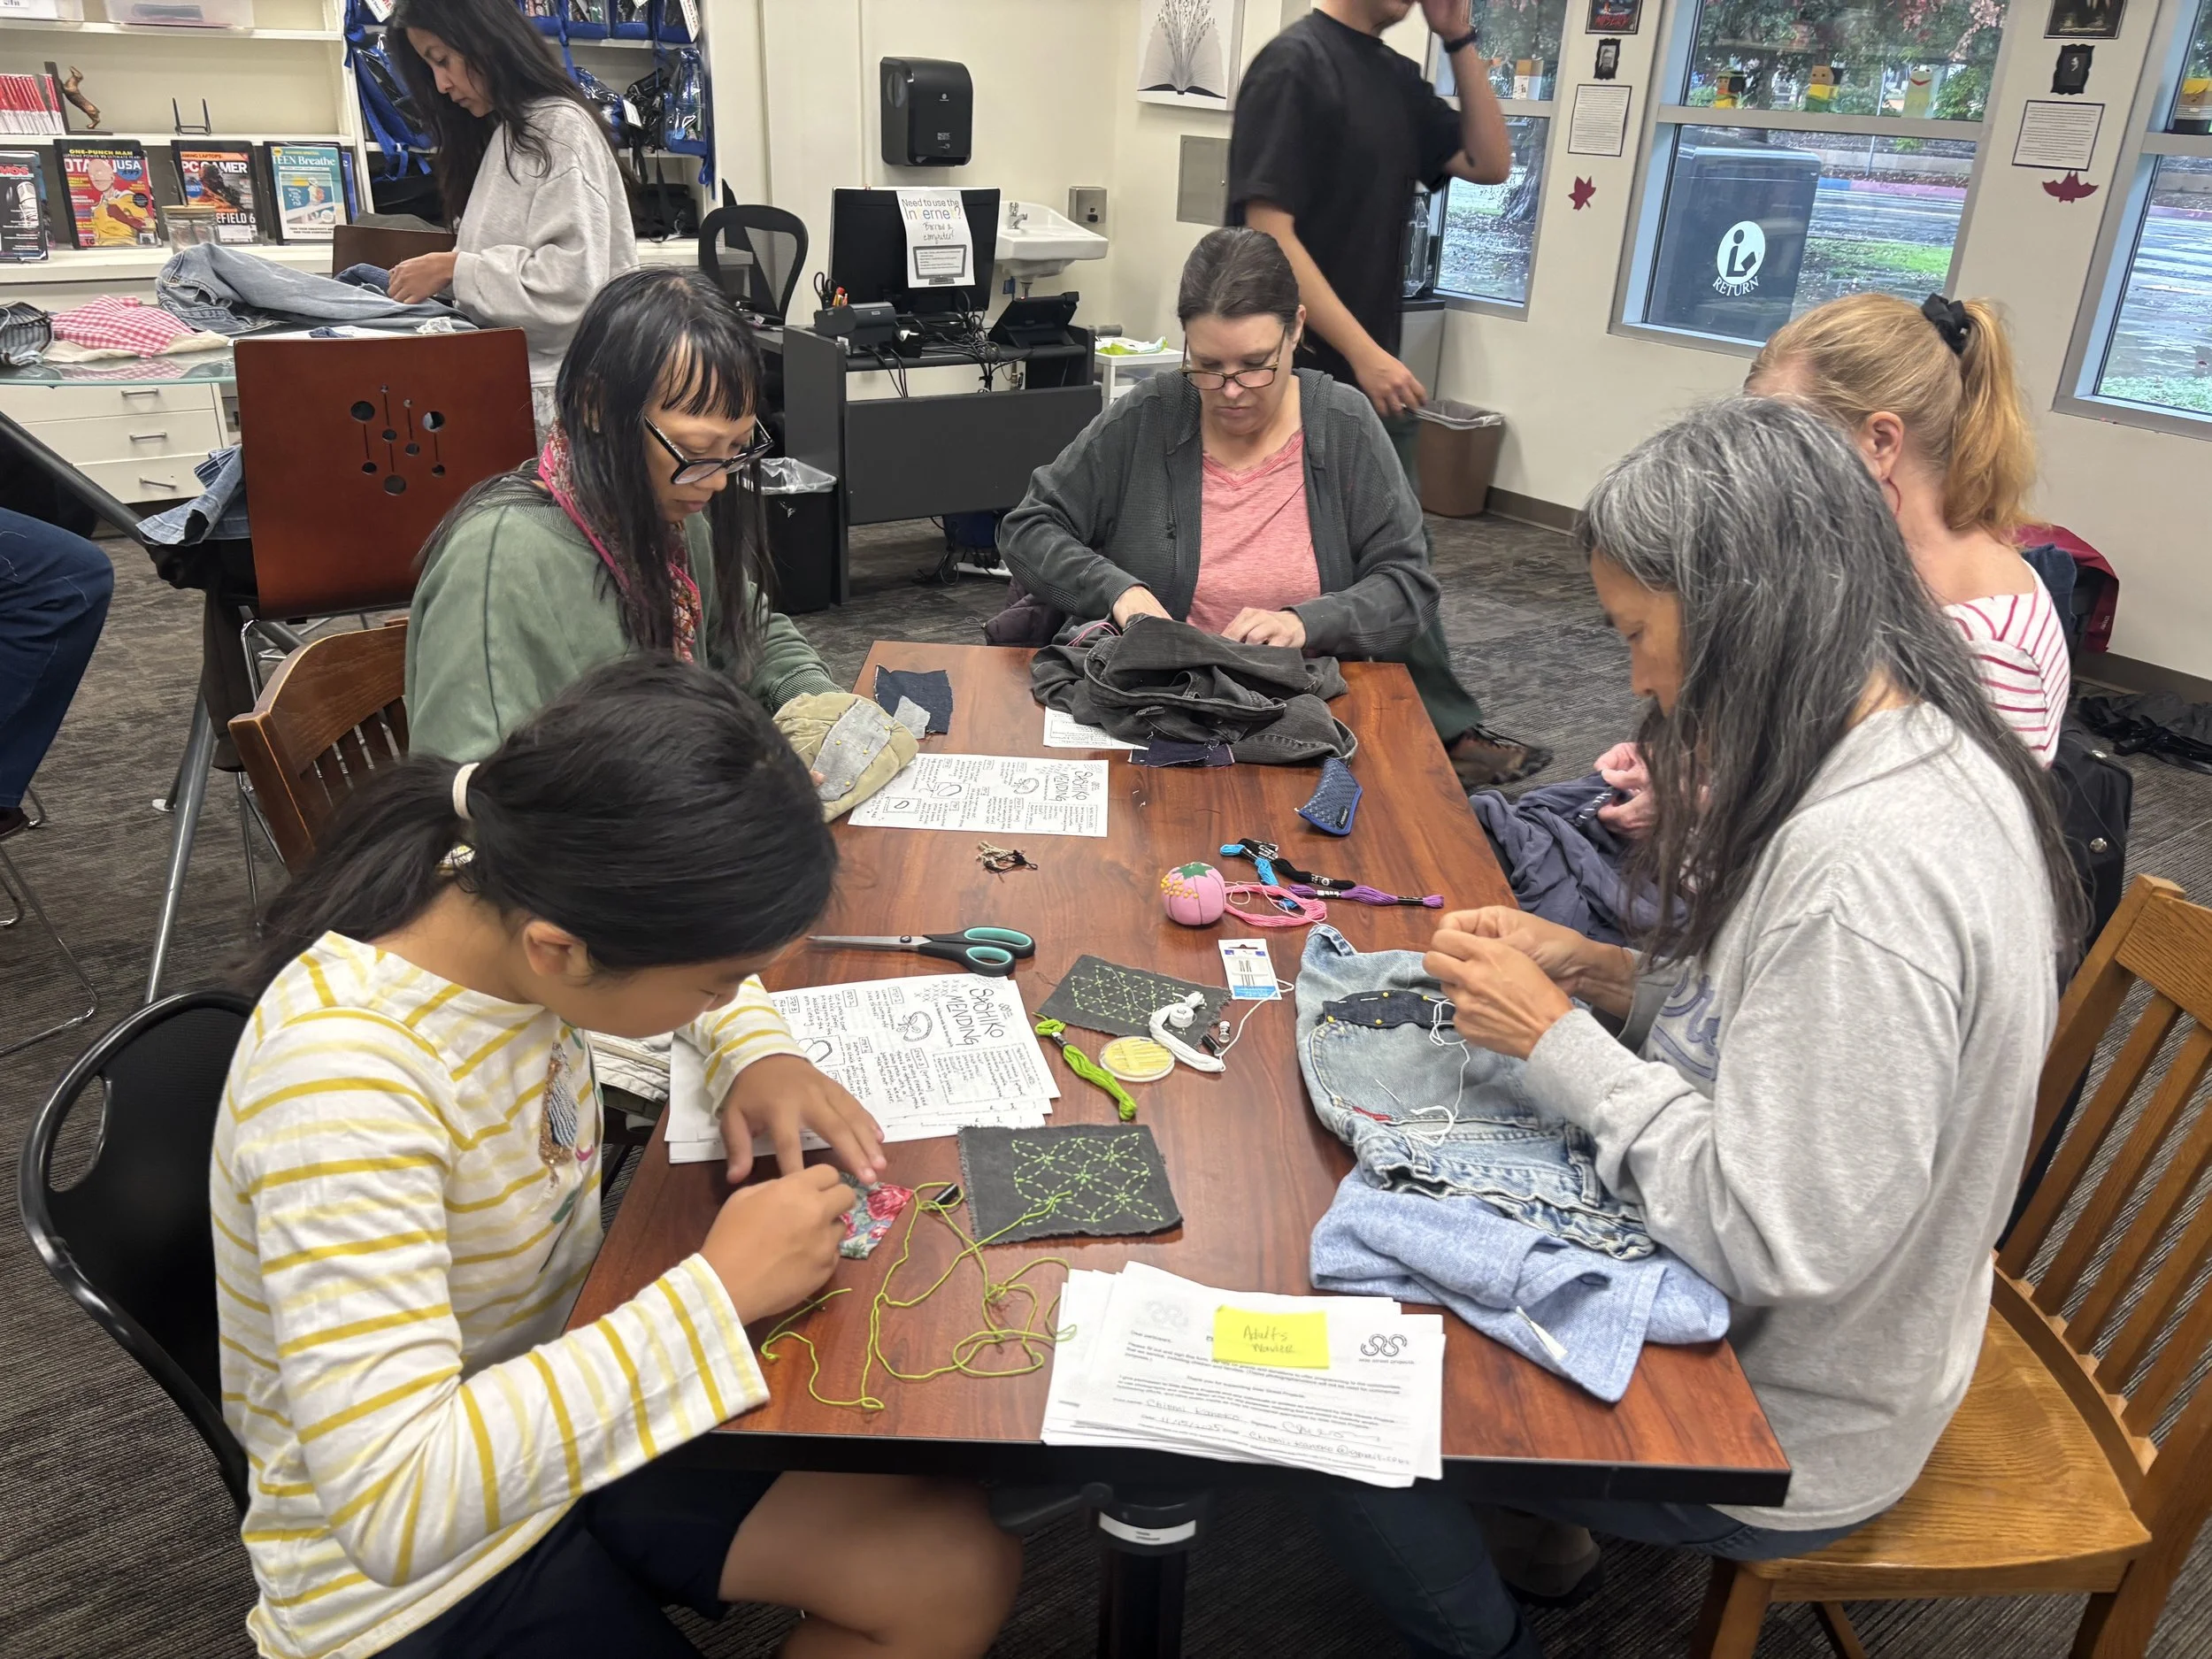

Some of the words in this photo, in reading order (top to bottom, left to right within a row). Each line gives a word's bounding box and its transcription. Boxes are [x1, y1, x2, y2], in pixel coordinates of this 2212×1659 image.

[65, 158, 117, 173] OTA
[117, 159, 142, 171] USA
[181, 160, 199, 173] PC
[298, 156, 335, 166] Breathe
[902, 198, 922, 207] Need
[947, 198, 959, 207] the
[250, 212, 256, 223] 6
[1712, 275, 1759, 296] RETURN
[1048, 772, 1070, 802] MENDING
[1071, 771, 1094, 801] SASHIKO
[946, 993, 982, 1046] MENDING
[970, 988, 1005, 1038] SASHIKO
